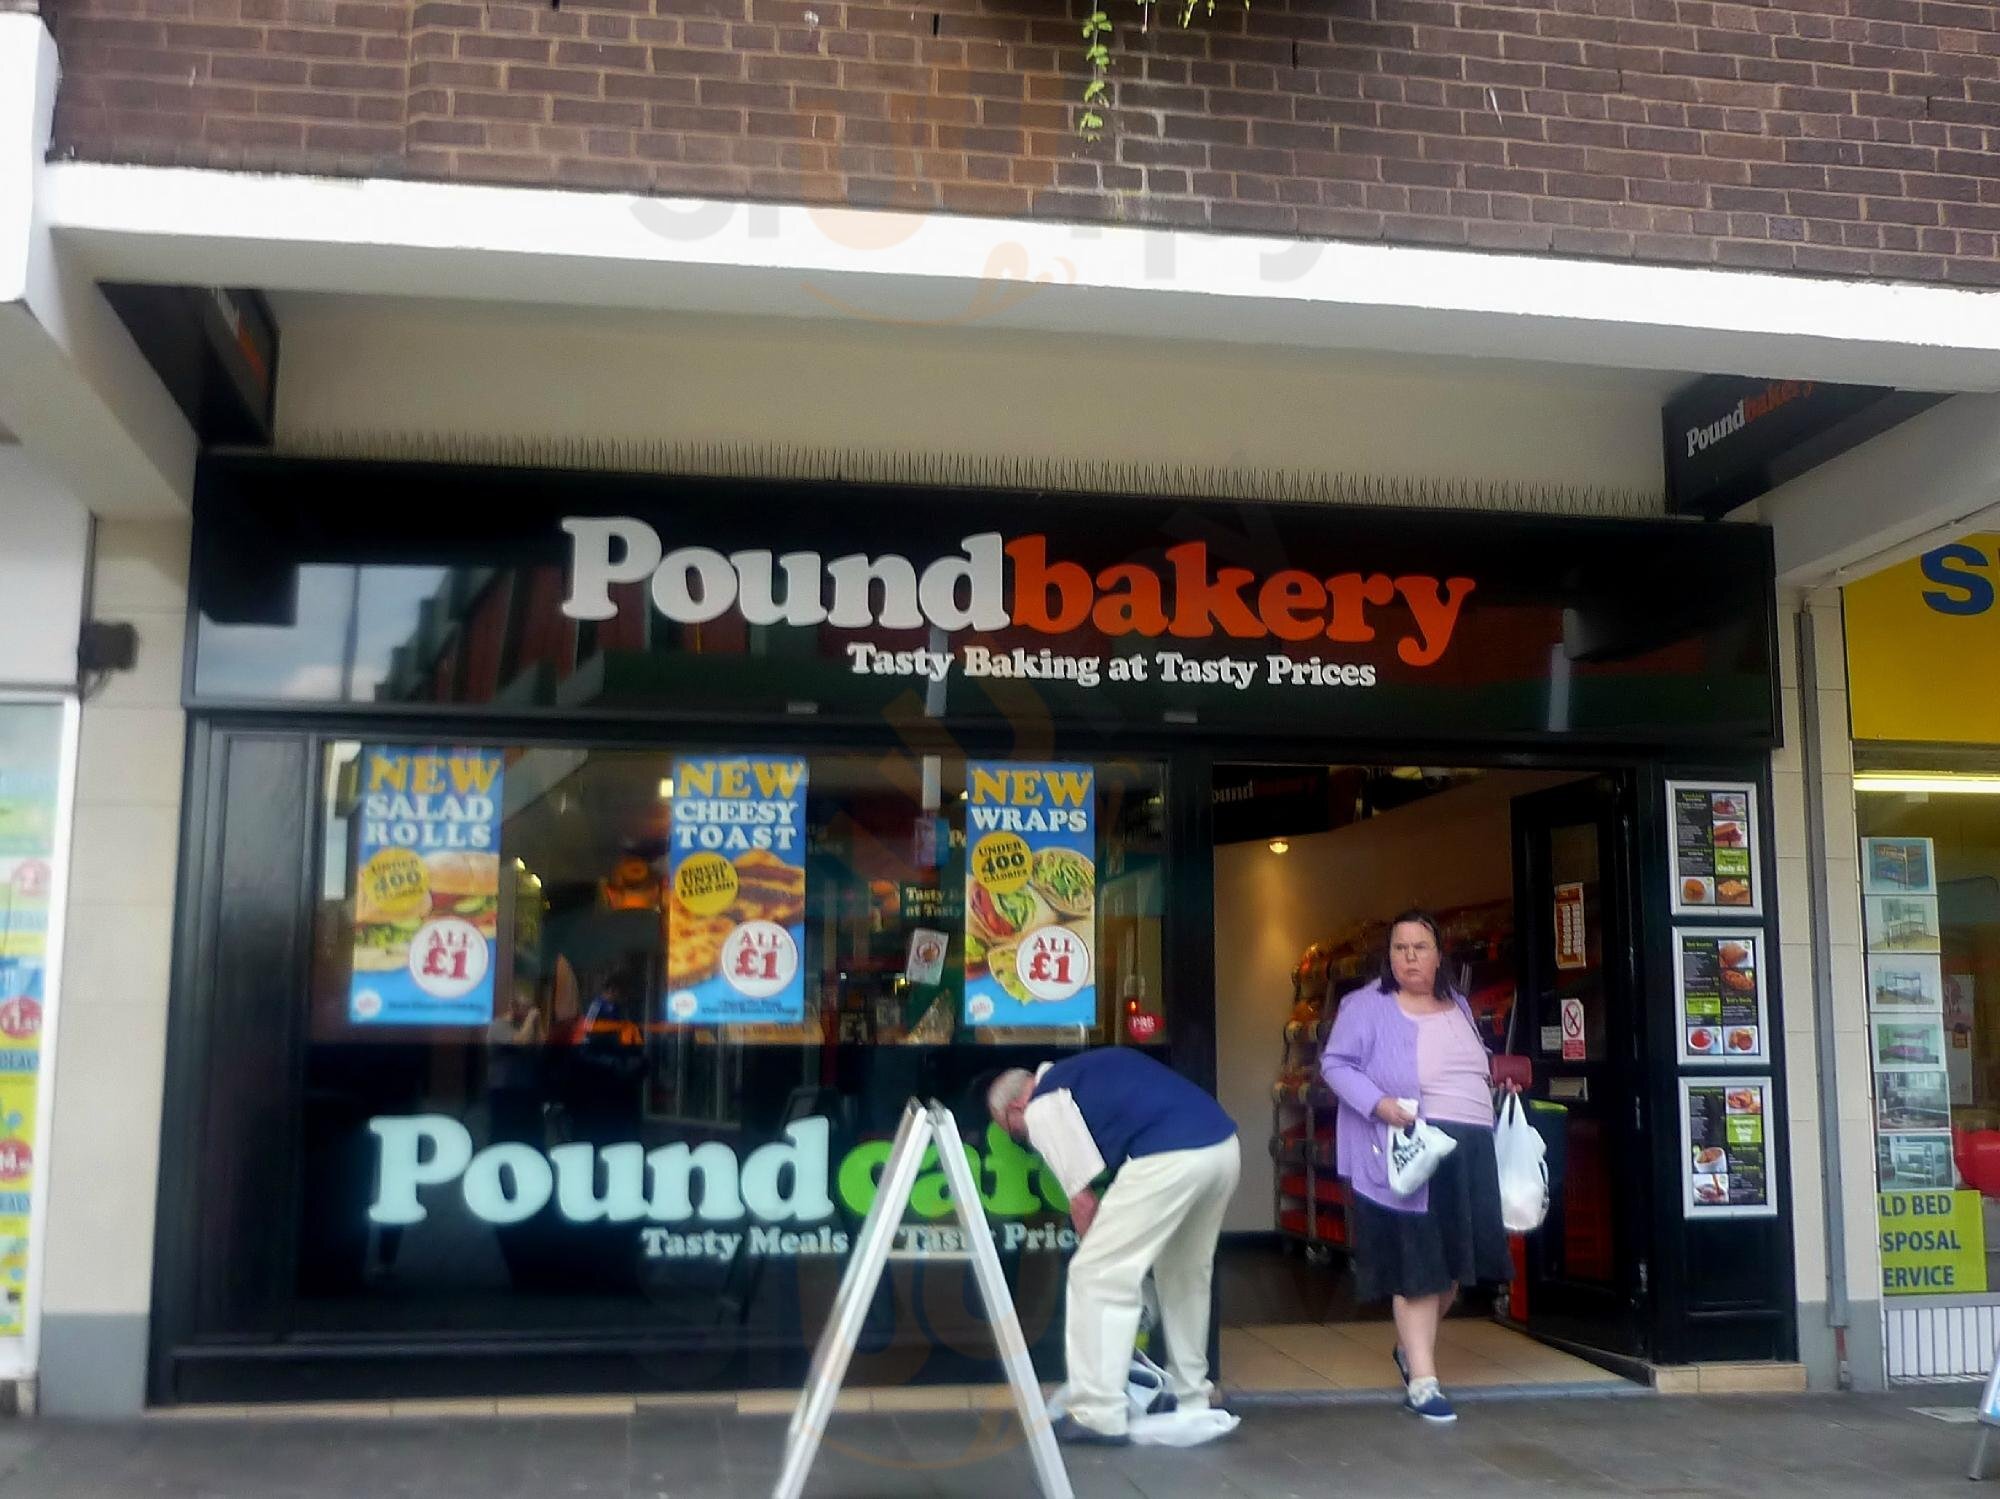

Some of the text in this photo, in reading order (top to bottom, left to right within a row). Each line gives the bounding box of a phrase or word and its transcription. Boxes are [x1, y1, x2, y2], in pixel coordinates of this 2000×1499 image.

[561, 516, 1476, 666] Poundbakery
[1921, 543, 1998, 616] S
[847, 641, 1376, 690] Tasty Baking at Tasty Prices
[368, 755, 501, 793] NEW
[677, 761, 804, 798] NEW
[970, 768, 1093, 807] NEW
[365, 794, 494, 822] SALAD
[674, 801, 800, 825] CHEESY
[970, 807, 1088, 833] WRAPS
[365, 822, 491, 847] ROLLS
[675, 825, 798, 850] TOAST
[978, 841, 1022, 857] UNDER
[982, 853, 1025, 876] 400
[427, 929, 470, 948] ALL
[739, 931, 783, 948] ALL
[1032, 935, 1075, 953] ALL
[422, 945, 470, 980] £1
[734, 947, 780, 981] £1
[1028, 953, 1074, 985] £1
[1879, 1194, 1951, 1216] LD BED
[642, 1226, 743, 1261] Tasty
[749, 1225, 849, 1255] Meals
[1004, 1222, 1080, 1251] Pric
[1882, 1265, 1954, 1288] ERVICE
